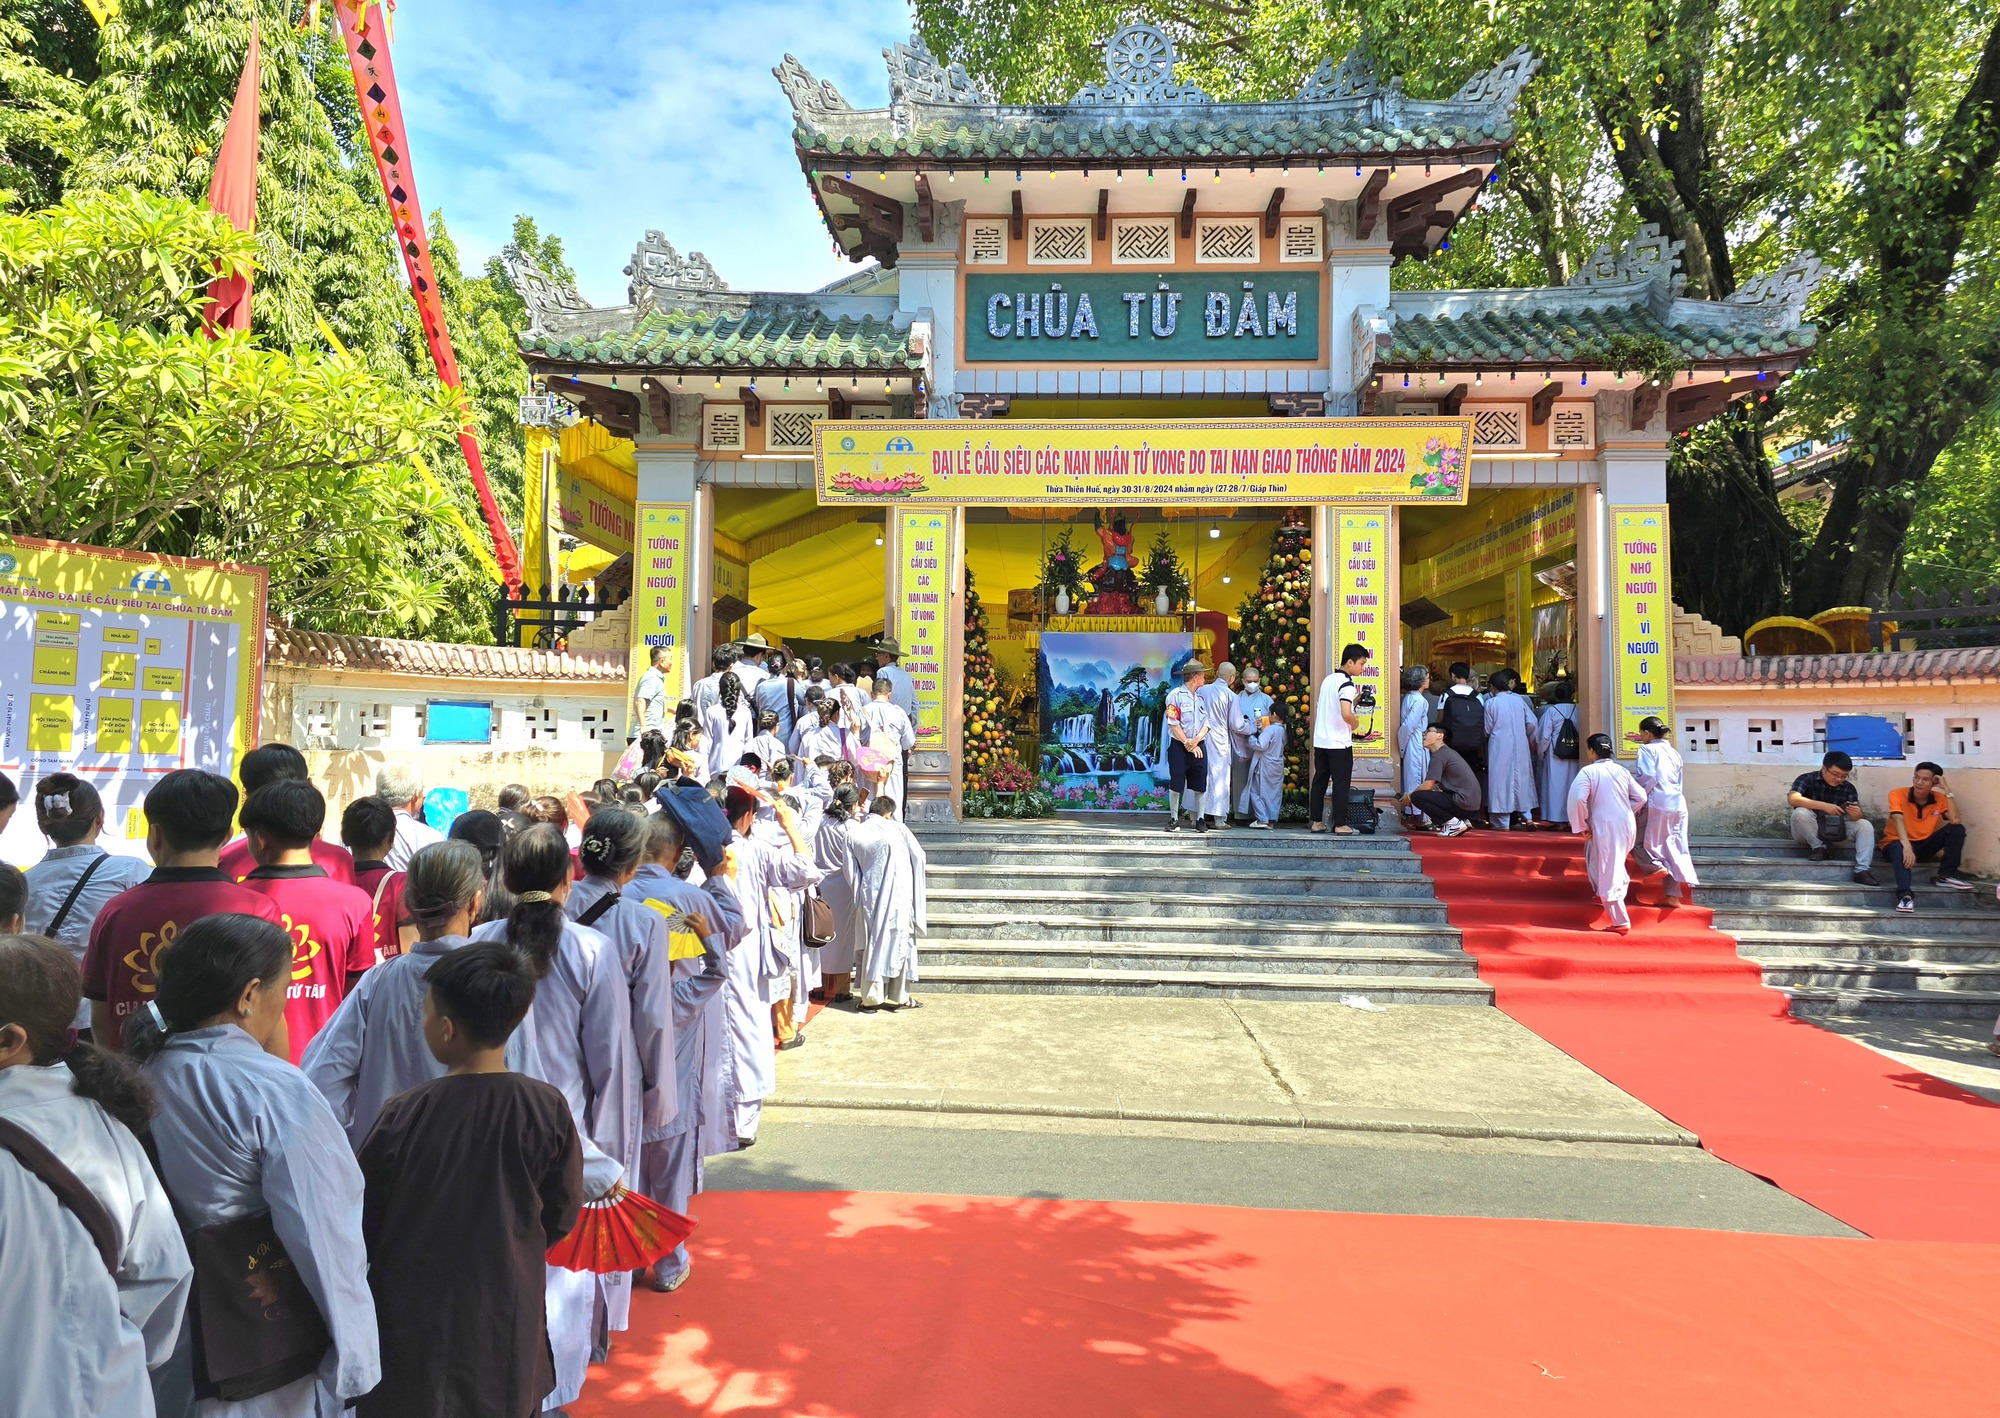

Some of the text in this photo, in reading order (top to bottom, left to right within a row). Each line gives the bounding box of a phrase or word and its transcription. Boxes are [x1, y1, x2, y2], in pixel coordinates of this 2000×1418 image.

[987, 280, 1298, 339] CHÙA TỪ ĐÀM
[932, 440, 1405, 481] ĐẠI LỄ CẦU SIÊU CÁC NẠN NHÂN TỬ VONG DO TAI NẠN GIAO THÔNG NĂM 2024
[1065, 485, 1084, 493] Thiên
[1086, 484, 1102, 494] Huế,
[1103, 485, 1120, 494] ngày
[1122, 485, 1173, 493] 30-31/8/2024
[1196, 484, 1213, 494] ngày
[589, 499, 635, 544] TƯỞNG NH
[648, 535, 679, 550] TƯỞNG
[915, 541, 925, 553] ĐẠI
[1353, 542, 1363, 554] ĐẠI
[1624, 539, 1657, 554] TƯỞNG
[652, 556, 672, 569] NHỚ
[924, 556, 937, 568] SIÊU
[1362, 558, 1375, 570] SIÊU
[1630, 560, 1651, 574] NHỚ
[647, 575, 676, 588] NGƯỜI
[918, 574, 929, 586] CÁC
[1356, 575, 1368, 587] CÁC
[1626, 580, 1657, 594] NGƯỜI
[656, 596, 666, 608] ĐI
[908, 591, 938, 605] NẠN NHÂN
[1346, 593, 1377, 608] NẠN NHÂN
[59, 593, 78, 603] ĐẠI
[122, 598, 143, 608] SIÊU
[146, 602, 161, 611] TẠI
[164, 603, 193, 613] CHÙA
[196, 605, 210, 614] TỪ
[211, 607, 233, 617] ĐÀM
[1637, 603, 1647, 614] ĐI
[658, 613, 667, 627] VÌ
[920, 610, 935, 620] VONG
[1358, 613, 1374, 623] VONG
[919, 628, 926, 638] DO
[1640, 620, 1650, 634] VÌ
[645, 632, 674, 647] NGƯỜI
[1358, 631, 1365, 641] DO
[911, 645, 933, 658] TAI NẠN
[1627, 640, 1659, 654] NGƯỜI
[905, 661, 938, 673] GIAO THÔNG
[1641, 659, 1647, 674] Ở
[922, 681, 936, 690] 2024
[1635, 683, 1651, 697] LẠI
[383, 945, 398, 956] ÂM
